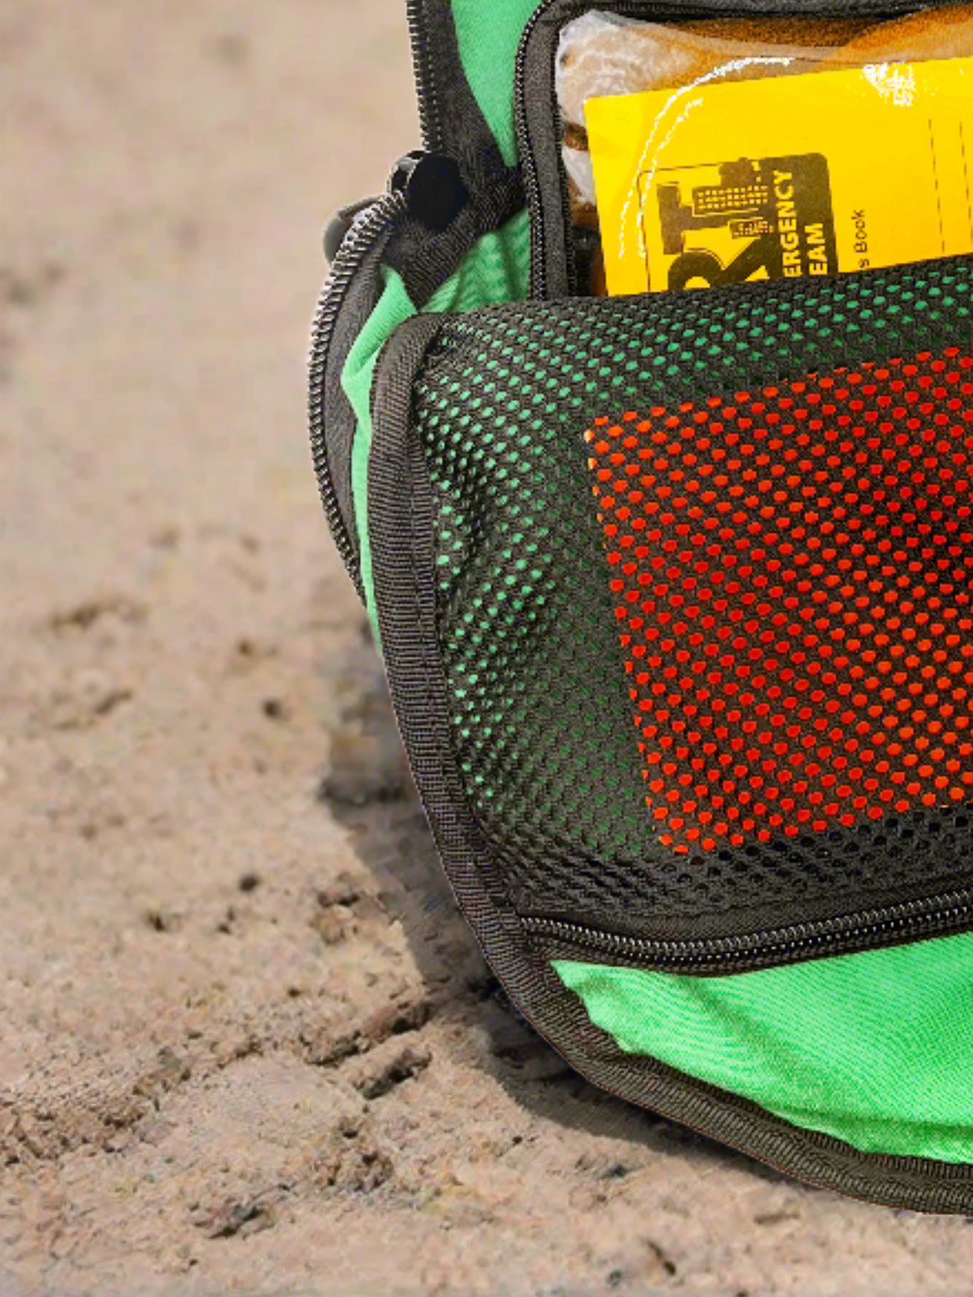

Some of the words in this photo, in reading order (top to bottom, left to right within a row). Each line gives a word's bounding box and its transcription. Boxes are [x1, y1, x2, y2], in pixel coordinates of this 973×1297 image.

[773, 169, 802, 277] ERGENCY
[804, 222, 829, 276] EAM
[851, 209, 868, 254] Book
